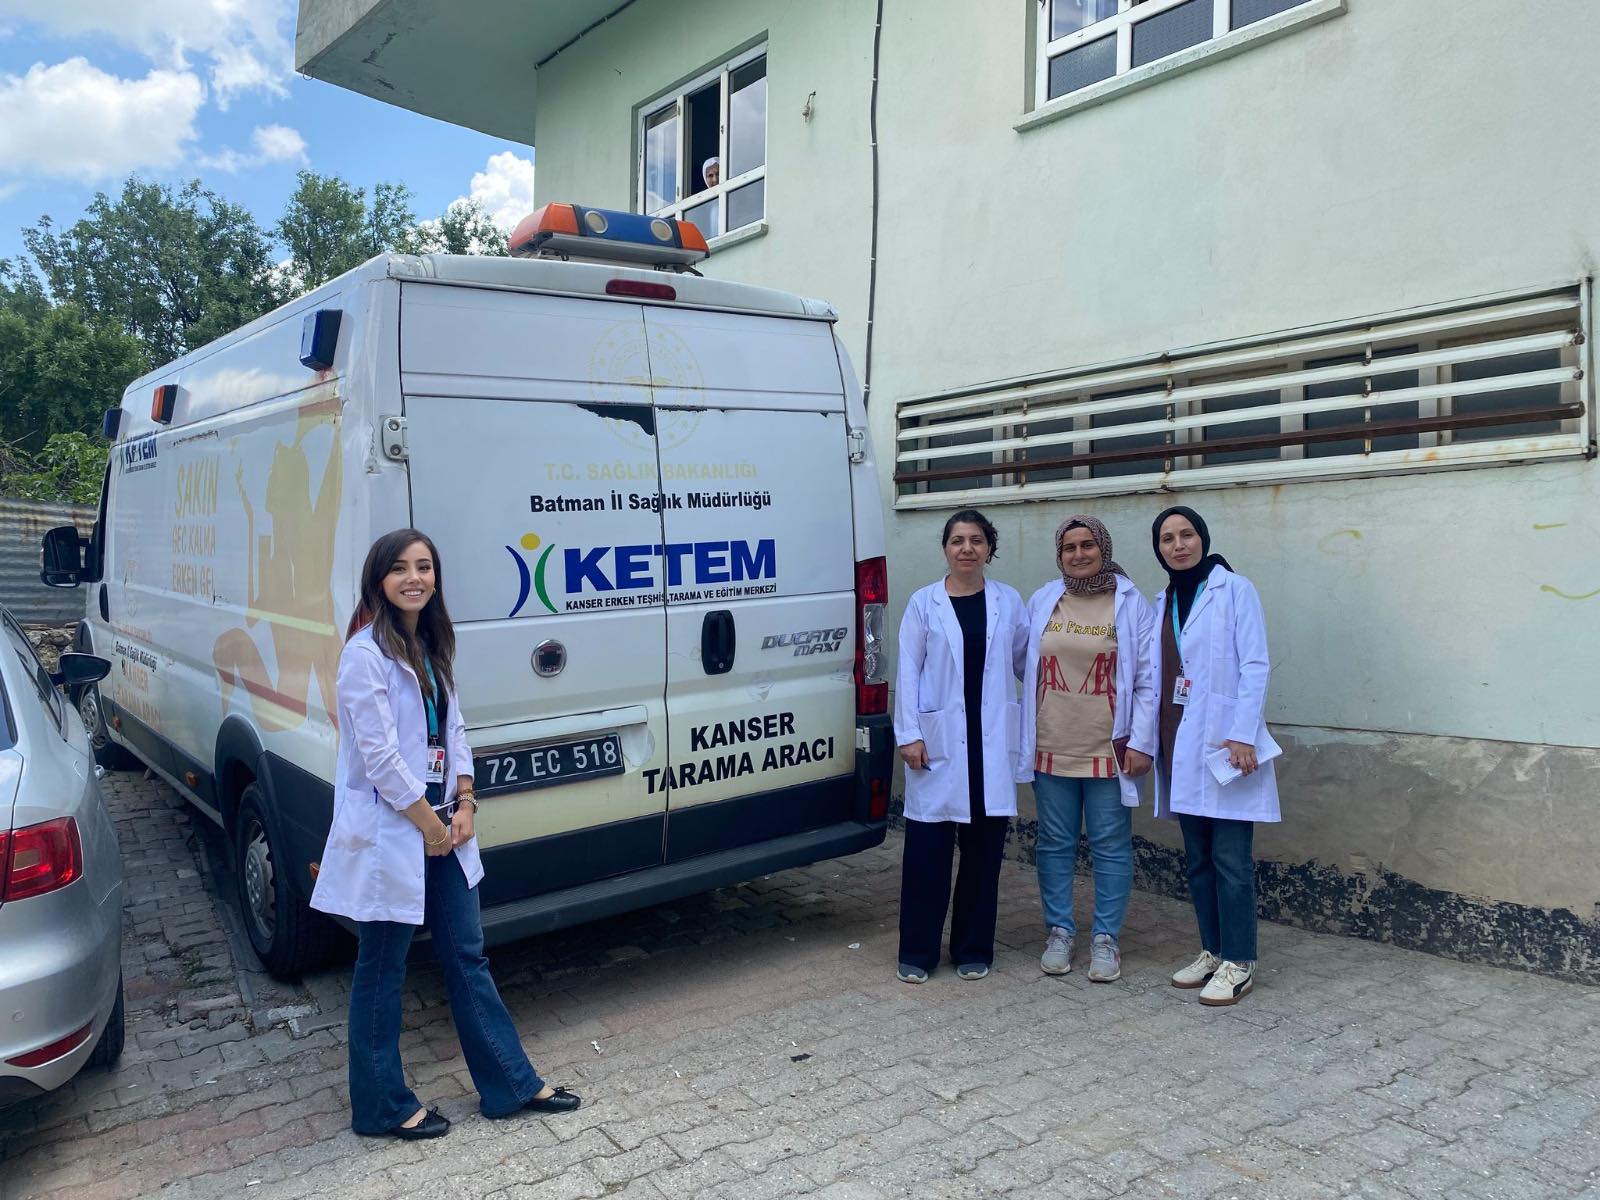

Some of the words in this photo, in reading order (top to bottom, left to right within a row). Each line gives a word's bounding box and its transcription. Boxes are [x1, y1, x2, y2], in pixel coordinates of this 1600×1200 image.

[545, 463, 580, 481] T.C.
[586, 460, 659, 481] SAĞLIK
[663, 460, 758, 480] BAKANLIĞI
[530, 494, 605, 513] Batman
[611, 490, 622, 510] İl
[629, 493, 683, 513] Sağlık
[687, 491, 772, 510] Müdürlüğü
[564, 539, 777, 594] KETEM
[566, 598, 603, 611] KANSER
[605, 595, 635, 608] ERKEN
[703, 590, 715, 599] VE
[716, 585, 743, 598] EĞİTİM
[744, 582, 777, 595] MERKEZİ
[761, 627, 848, 650] DUCATO
[793, 641, 842, 657] MAXI
[691, 712, 795, 752] KANSER
[486, 756, 518, 784] 72
[530, 749, 561, 777] EC
[573, 741, 617, 768] 518
[643, 751, 754, 794] TARAMA
[762, 736, 834, 772] ARACI
